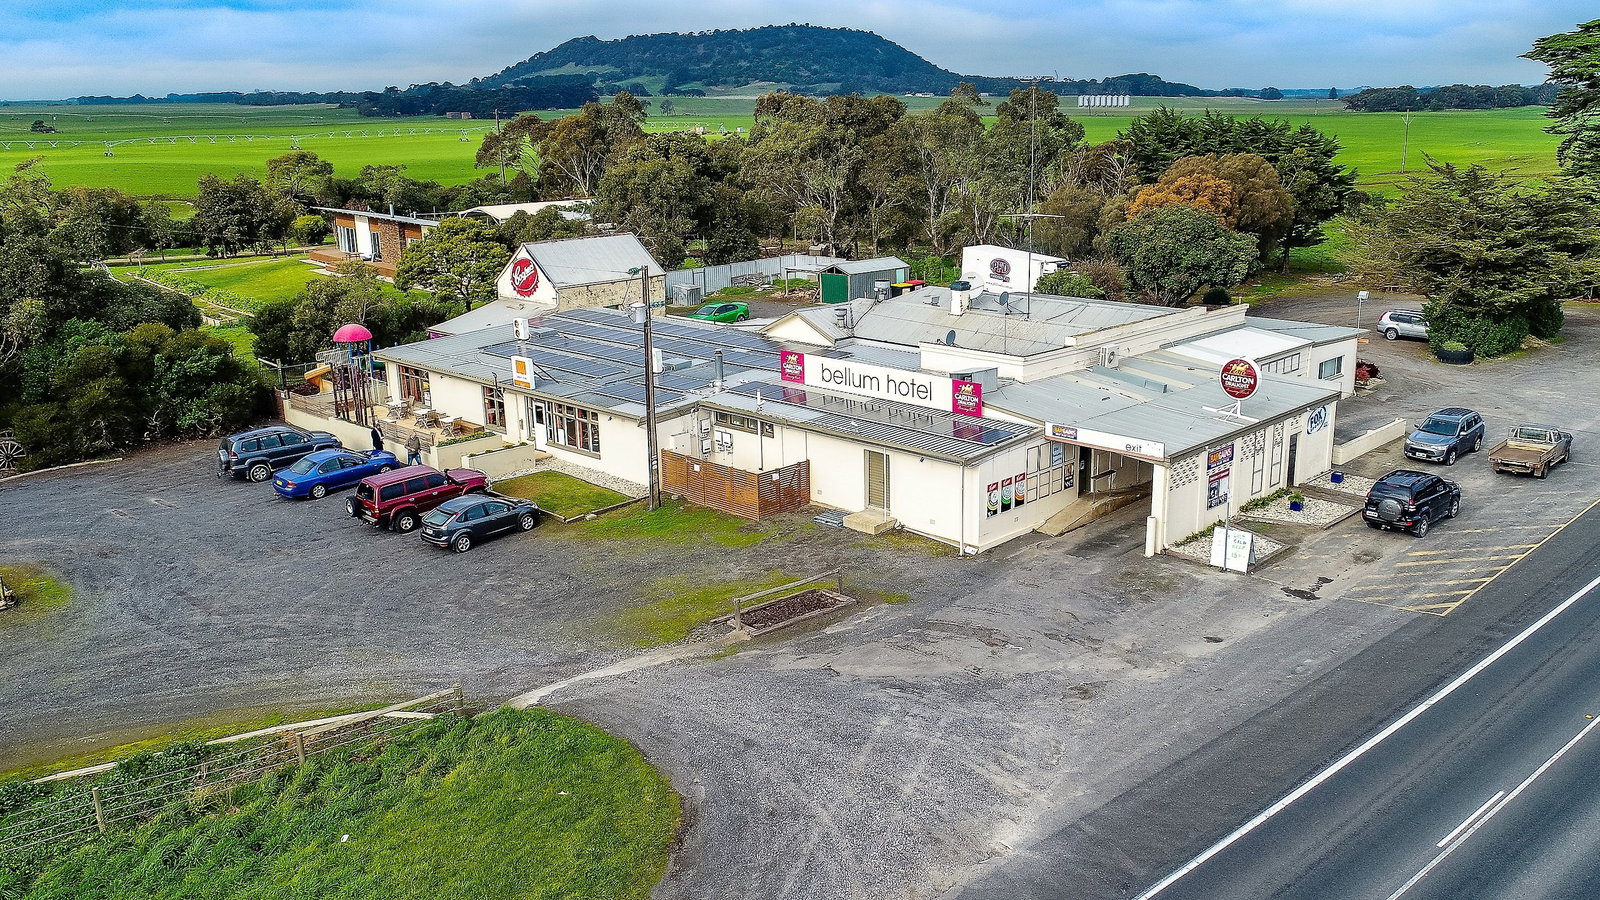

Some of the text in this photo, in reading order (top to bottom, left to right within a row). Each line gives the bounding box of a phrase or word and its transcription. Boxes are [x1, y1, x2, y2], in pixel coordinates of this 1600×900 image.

[782, 362, 803, 372] CARLTON
[821, 363, 932, 401] bellum hotel
[1222, 373, 1254, 385] CARLTON
[954, 393, 979, 403] CARLTON
[1310, 408, 1323, 429] FOX
[1125, 443, 1142, 453] exit
